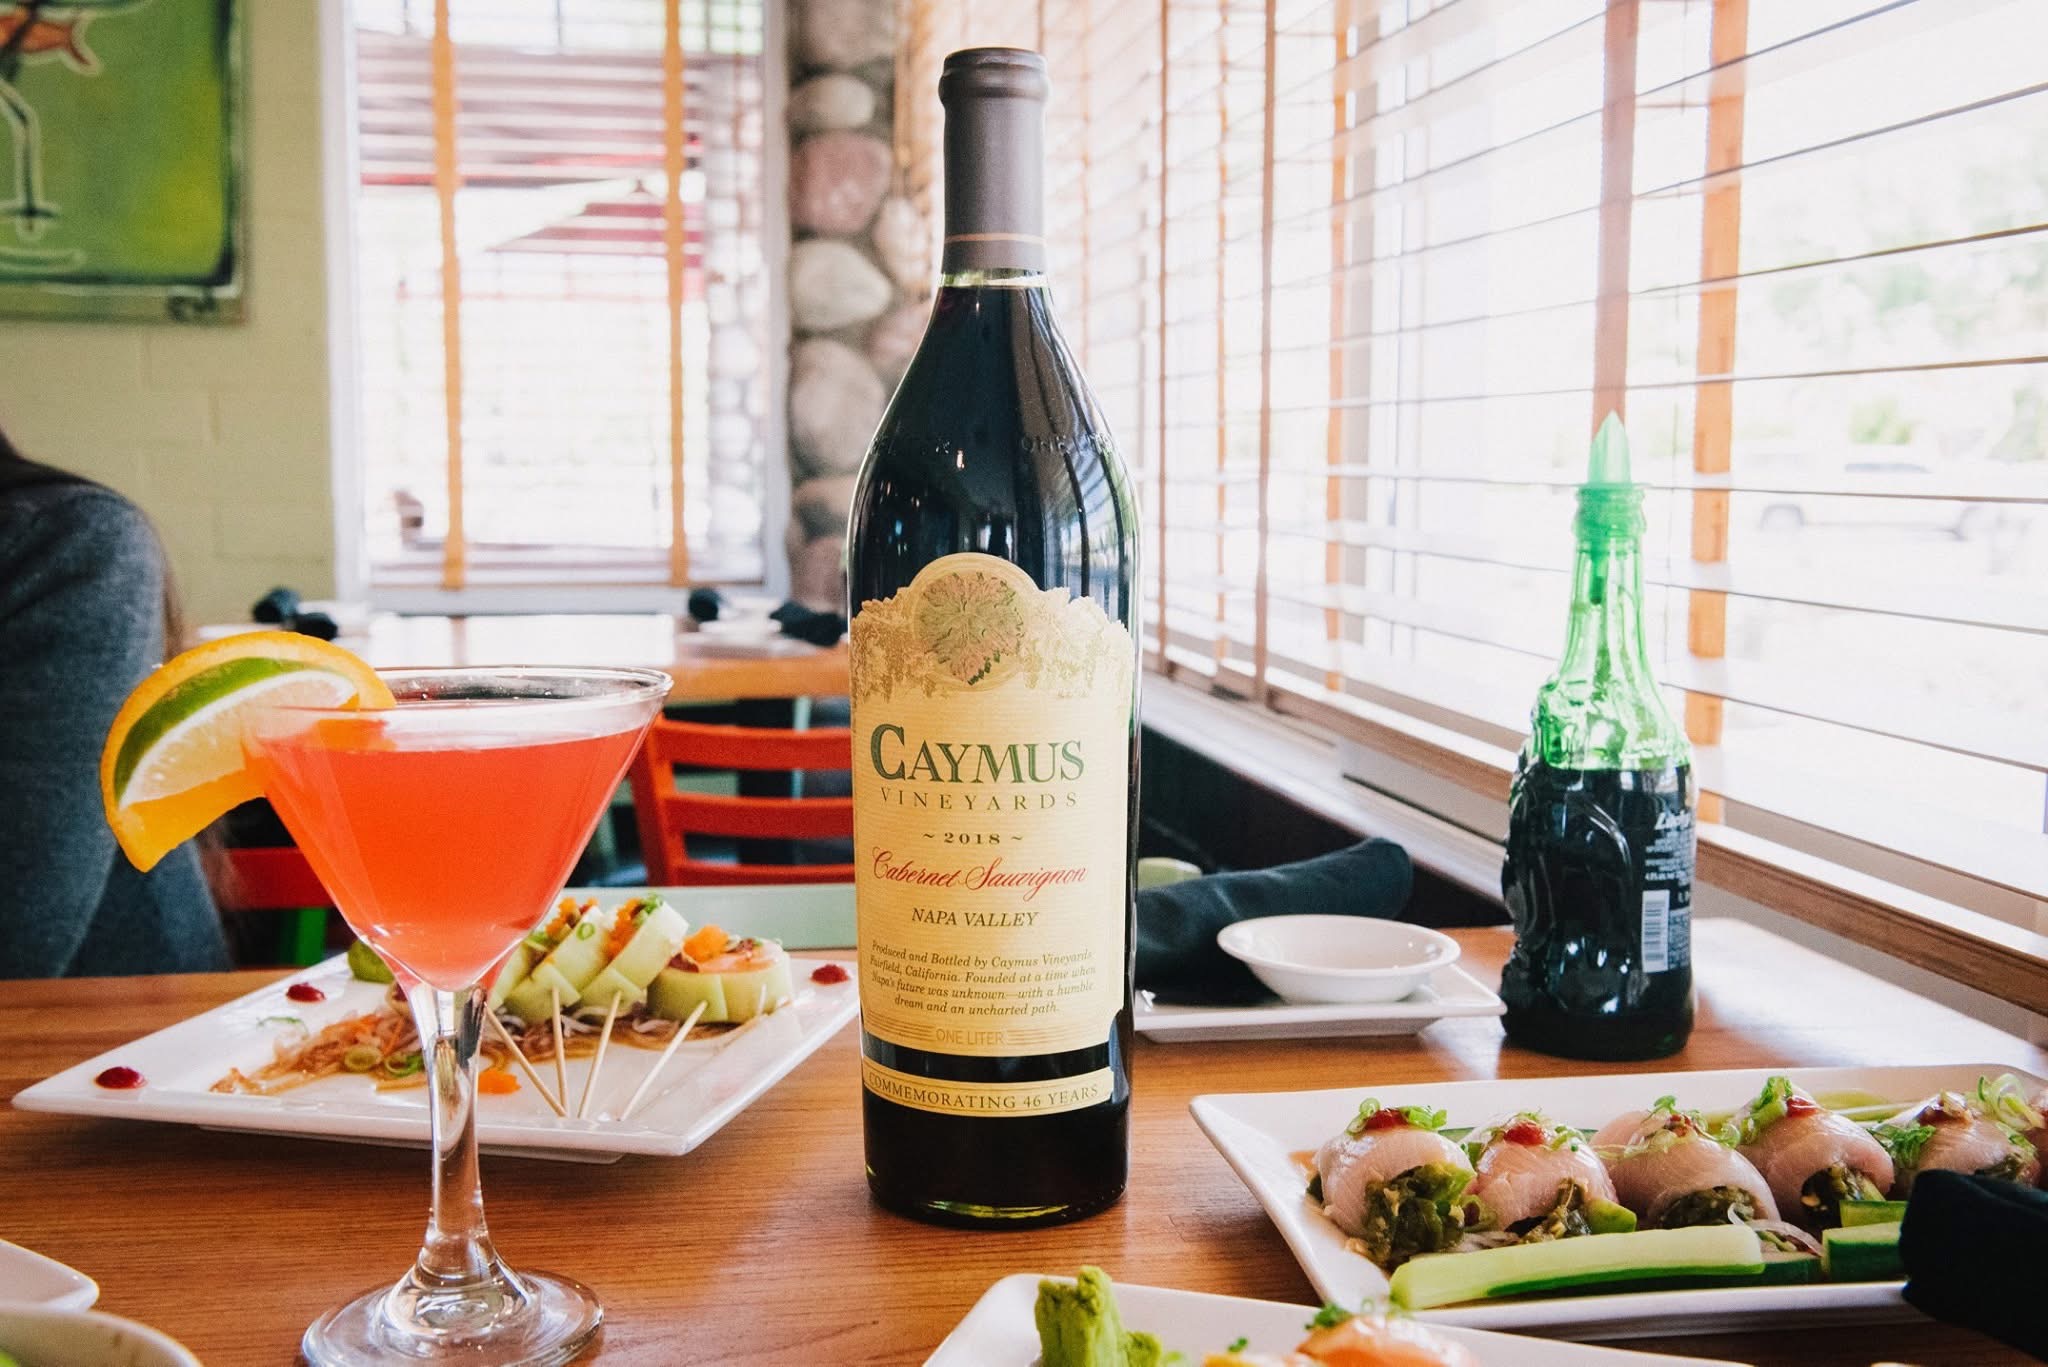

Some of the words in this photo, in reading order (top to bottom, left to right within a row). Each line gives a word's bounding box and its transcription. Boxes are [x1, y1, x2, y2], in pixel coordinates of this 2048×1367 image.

[870, 723, 1085, 784] CAYMUS
[880, 787, 1078, 810] VINEYARDS
[872, 846, 963, 888] Cabernet
[965, 856, 1088, 902] Sauvignon
[911, 907, 957, 926] NAPA
[964, 911, 1040, 927] VALLEY
[872, 940, 907, 960] Produced
[908, 952, 928, 964] and
[931, 953, 971, 968] Bottled
[974, 956, 988, 970] by
[991, 956, 1039, 970] Caymus
[1041, 948, 1093, 967] Vineyards
[870, 954, 903, 976] Fairfield,
[905, 964, 961, 982] California.
[965, 971, 1016, 984] Founded
[1019, 973, 1031, 983] at
[1034, 974, 1041, 982] a
[1045, 968, 1069, 982] time
[1071, 964, 1096, 979] when
[896, 979, 925, 994] future
[928, 986, 949, 997] was
[1046, 989, 1054, 998] a
[1056, 979, 1094, 997] humble
[894, 993, 923, 1010] dream
[926, 1002, 948, 1013] and
[950, 1005, 964, 1014] an
[968, 1002, 1028, 1017] uncharted
[1031, 1000, 1060, 1017] path.
[936, 1028, 964, 1045] ONE
[967, 1031, 1005, 1046] LITER
[868, 1071, 1016, 1110] COMMEMORATING
[1023, 1094, 1041, 1108] 46
[1047, 1083, 1099, 1106] YEARS
